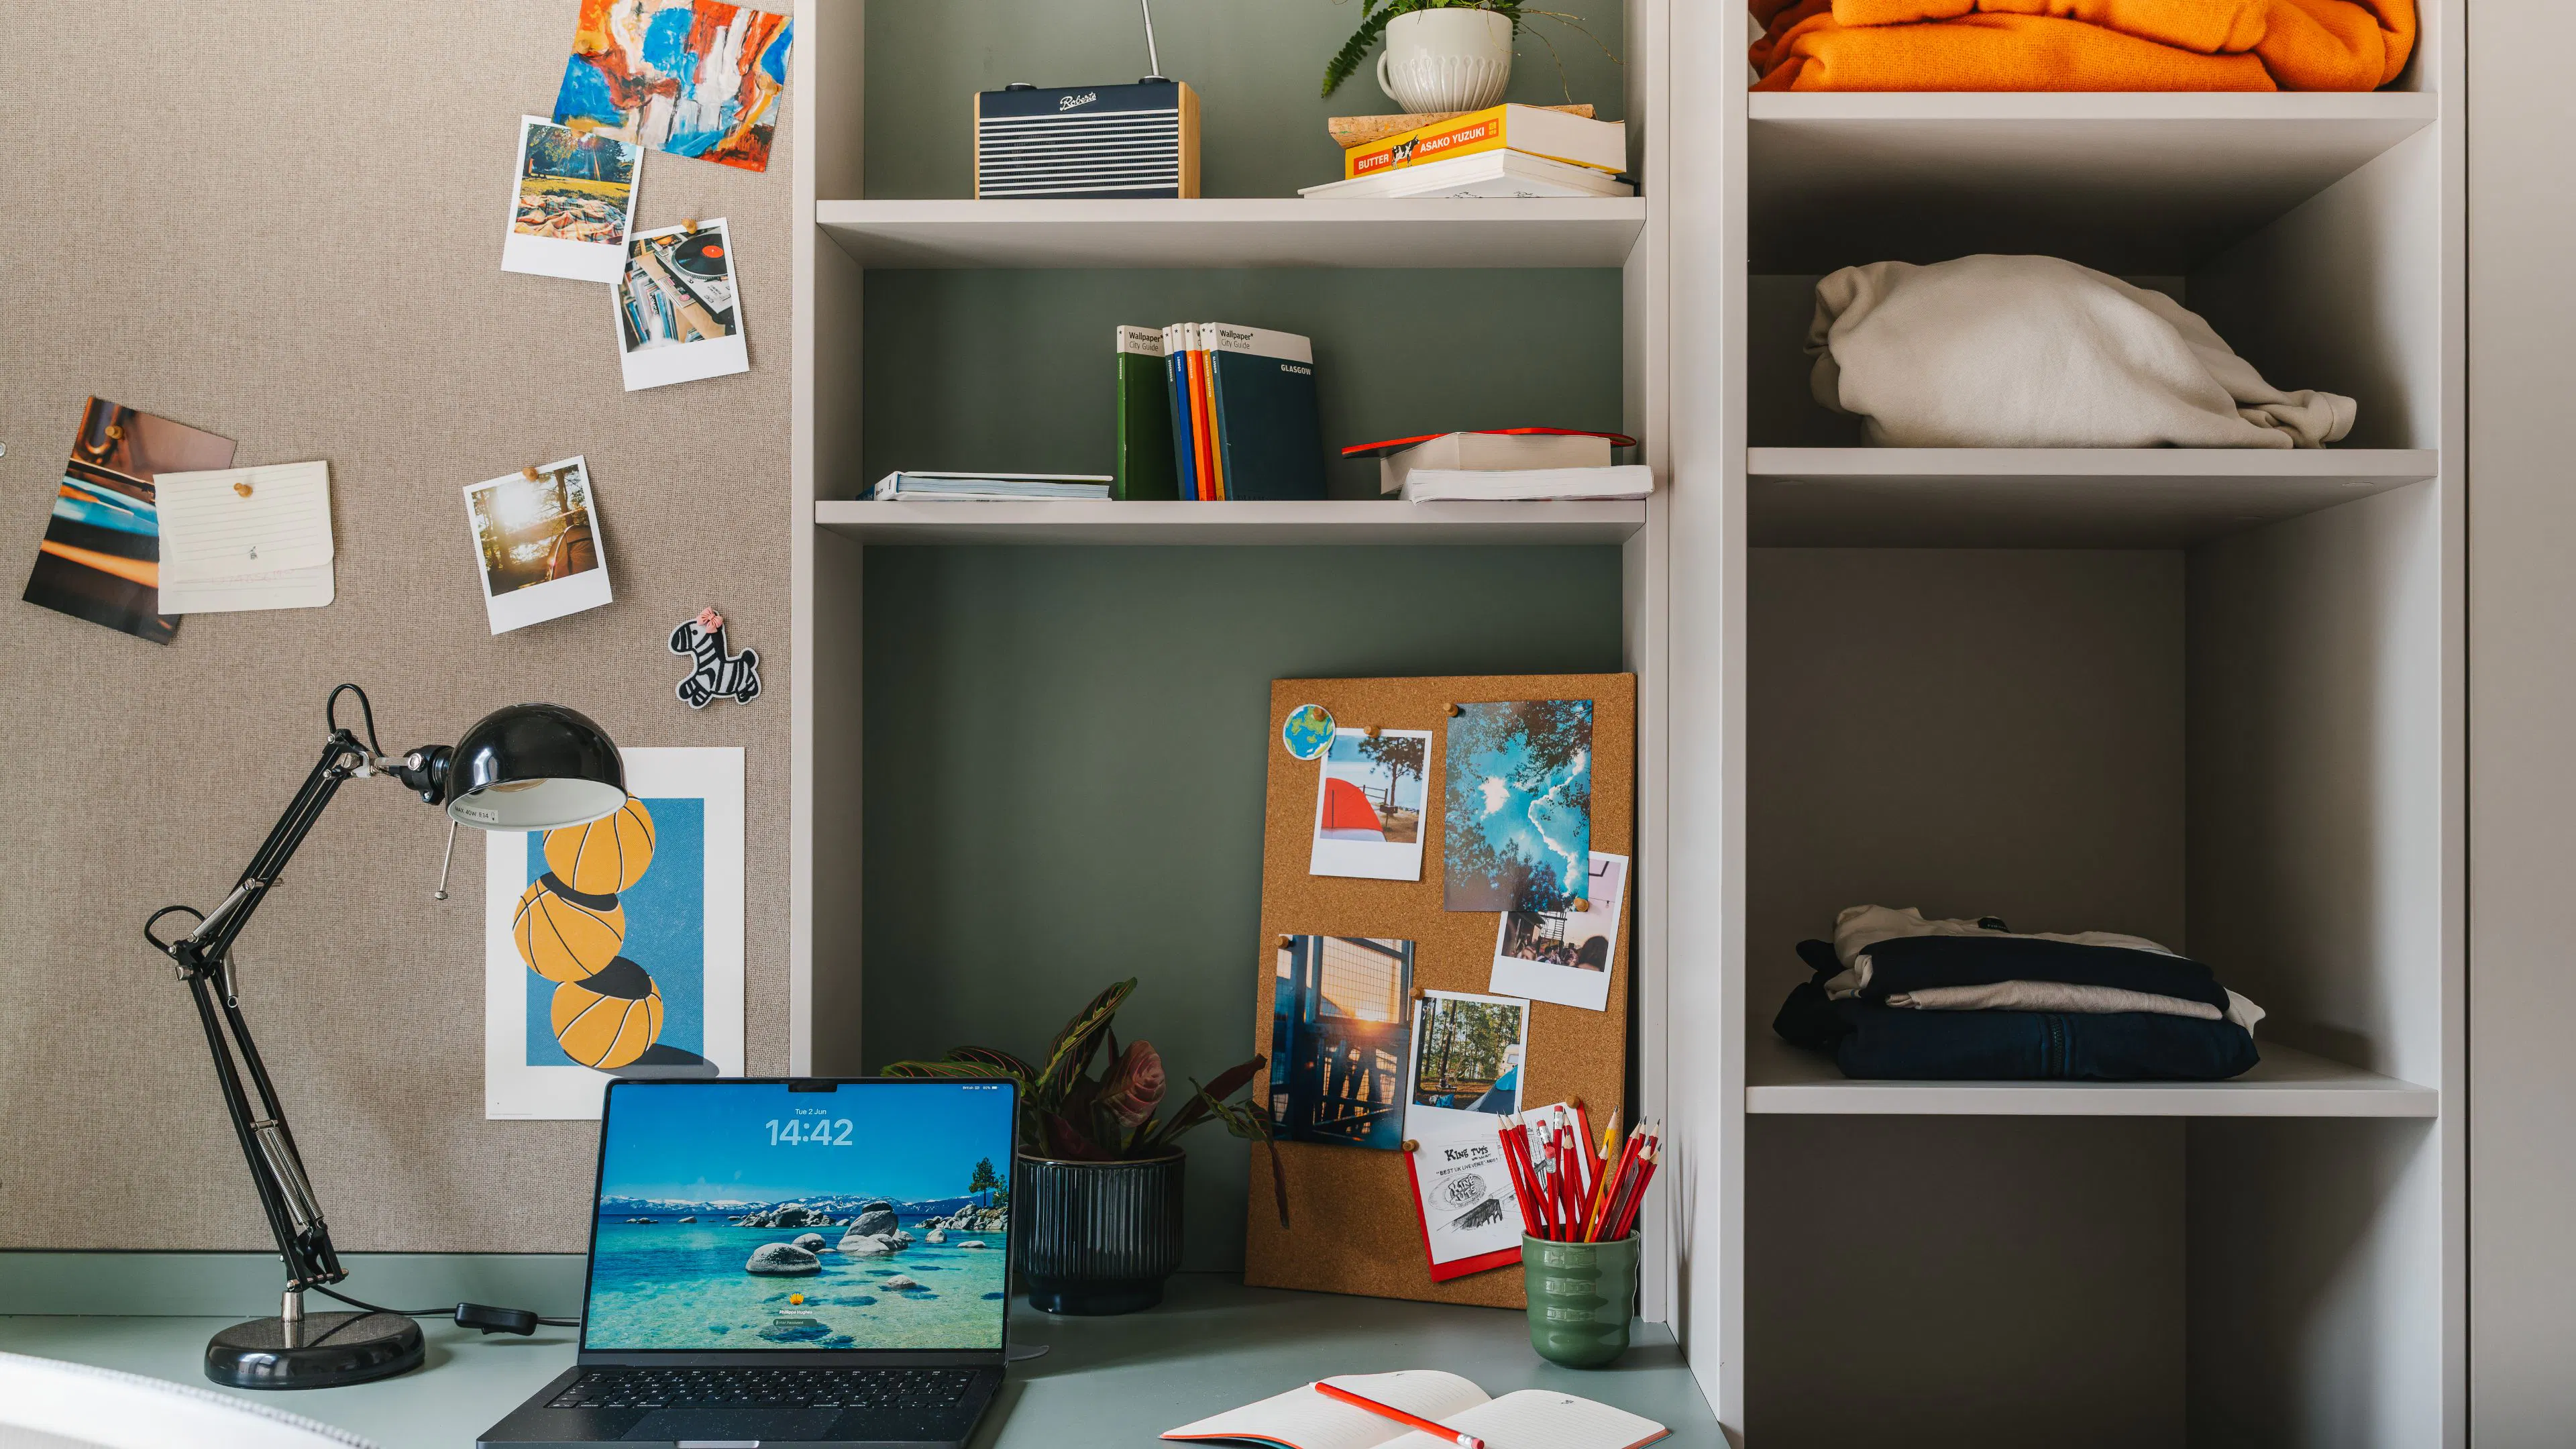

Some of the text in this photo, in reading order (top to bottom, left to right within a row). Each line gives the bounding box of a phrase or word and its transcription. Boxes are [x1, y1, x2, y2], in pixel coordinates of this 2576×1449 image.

[1059, 91, 1097, 111] Roberts
[1419, 136, 1450, 153] ASAKO
[1452, 127, 1485, 144] YUZUKI
[1358, 154, 1389, 170] BUTTER
[1129, 341, 1159, 352] City Guide
[1221, 339, 1250, 350] City Guide
[1281, 364, 1311, 376] GLASGOW
[455, 806, 464, 814] MAX
[466, 809, 477, 817] 40W
[765, 1118, 853, 1146] 14:42
